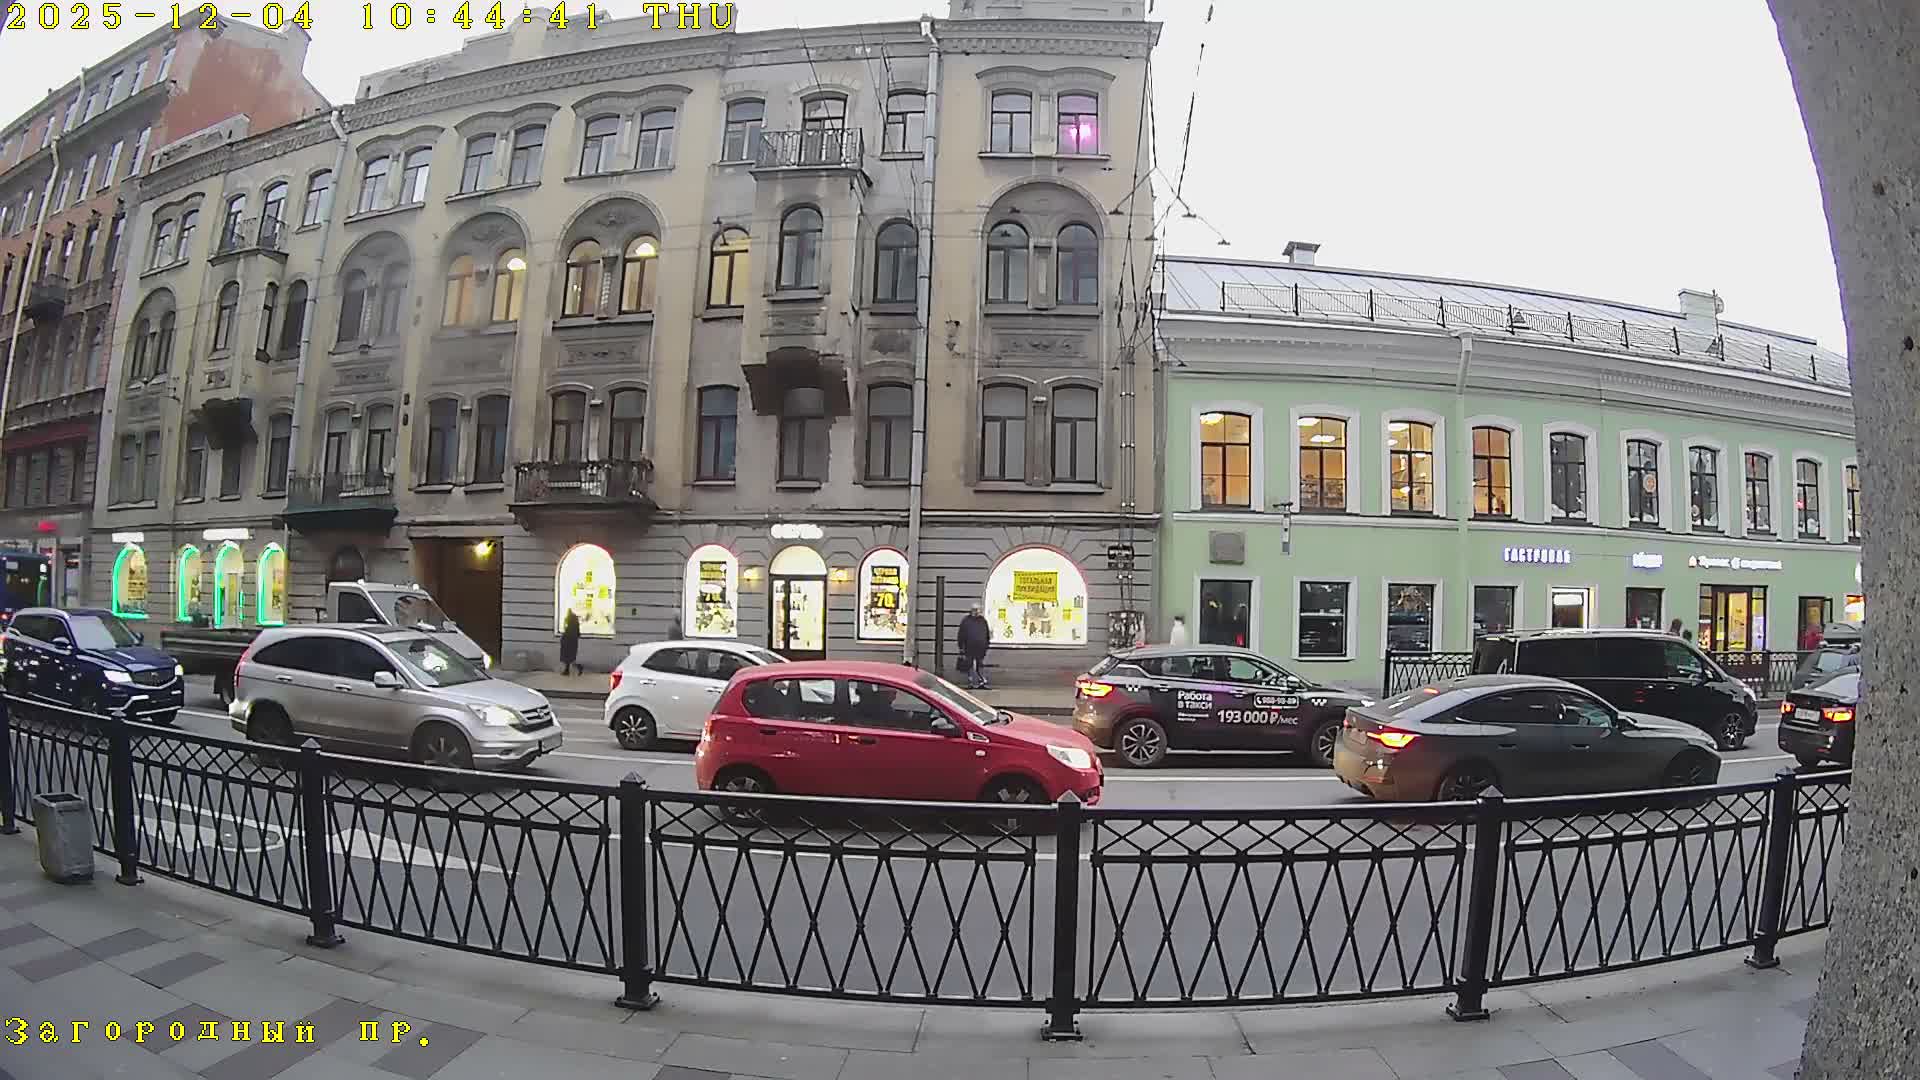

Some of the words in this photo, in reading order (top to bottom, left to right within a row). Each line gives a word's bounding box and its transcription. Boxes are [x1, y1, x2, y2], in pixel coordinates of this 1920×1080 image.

[1177, 690, 1213, 701] Работа
[1185, 701, 1213, 710] такси
[1217, 709, 1242, 723] 193
[1243, 711, 1269, 724] 000
